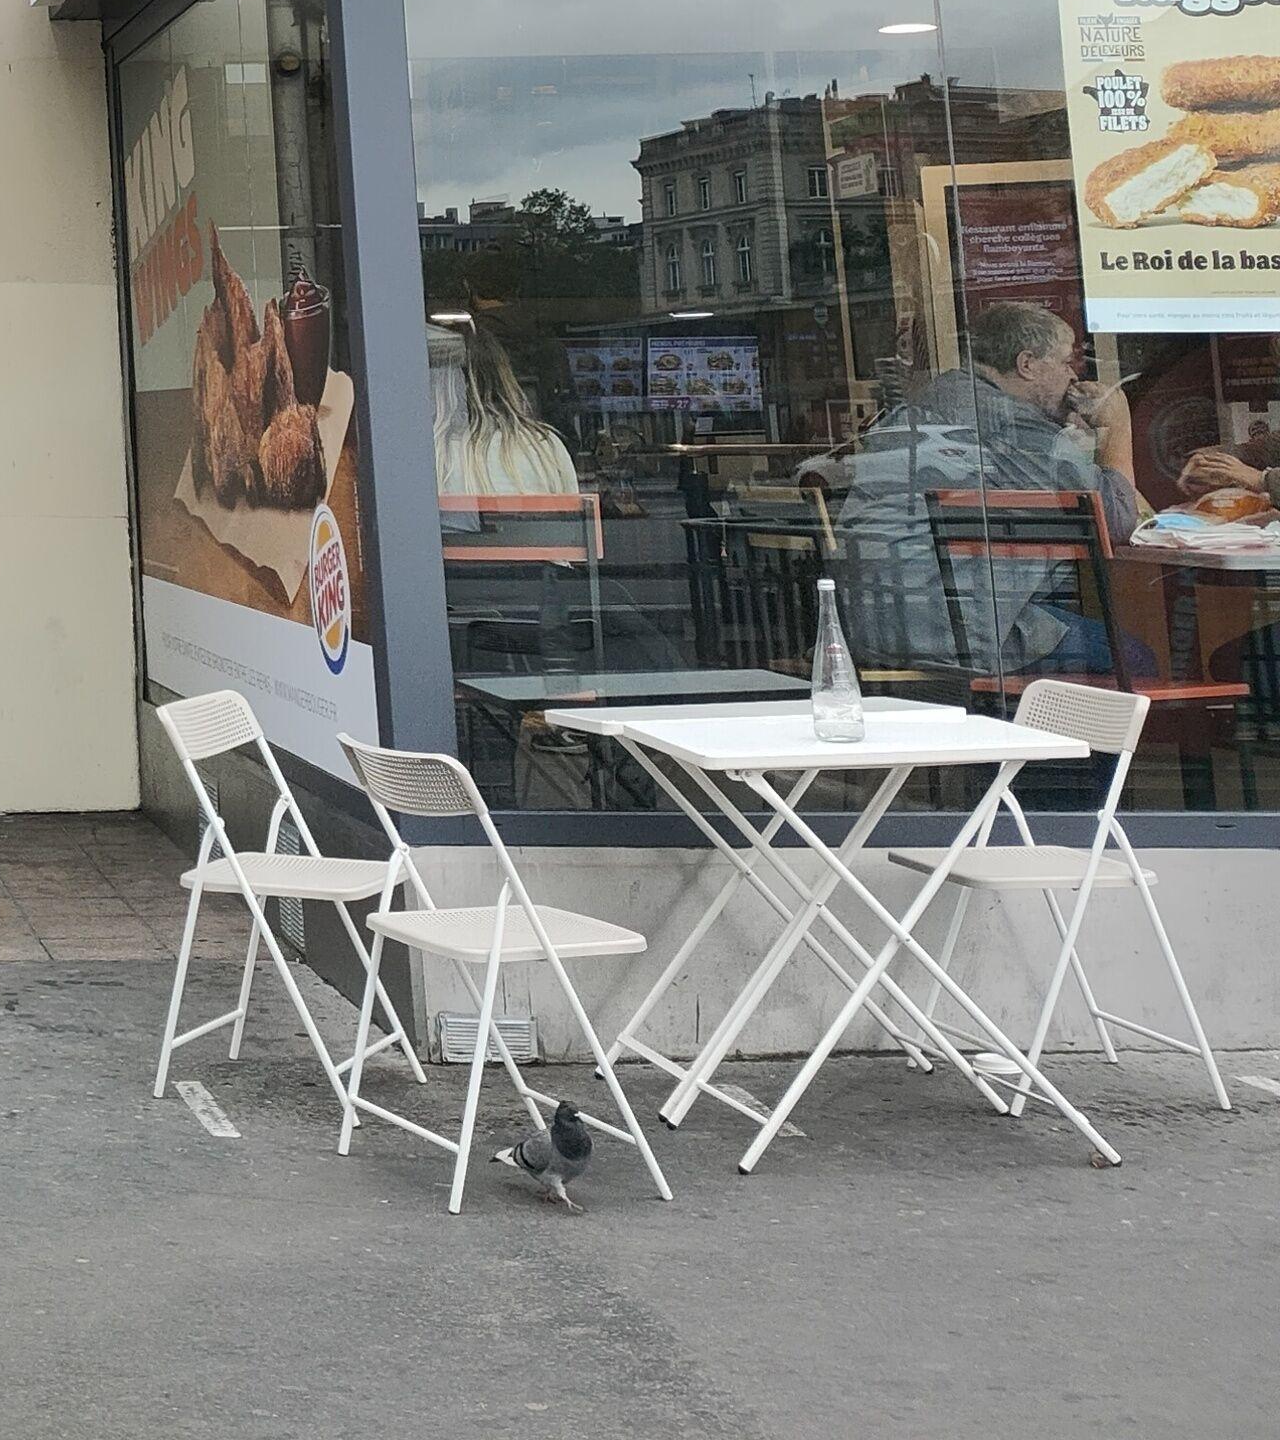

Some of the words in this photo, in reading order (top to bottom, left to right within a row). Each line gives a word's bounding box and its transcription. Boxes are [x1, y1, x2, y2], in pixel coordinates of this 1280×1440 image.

[1080, 26, 1143, 43] NATURE
[1096, 76, 1141, 90] POULET
[1099, 115, 1148, 131] FILETS
[1100, 252, 1128, 271] Le
[1132, 250, 1173, 271] Roi
[1178, 250, 1208, 271] de
[1212, 250, 1236, 271] la
[1239, 250, 1280, 271] bas
[314, 541, 342, 592] BURGER
[317, 569, 344, 631] KING
